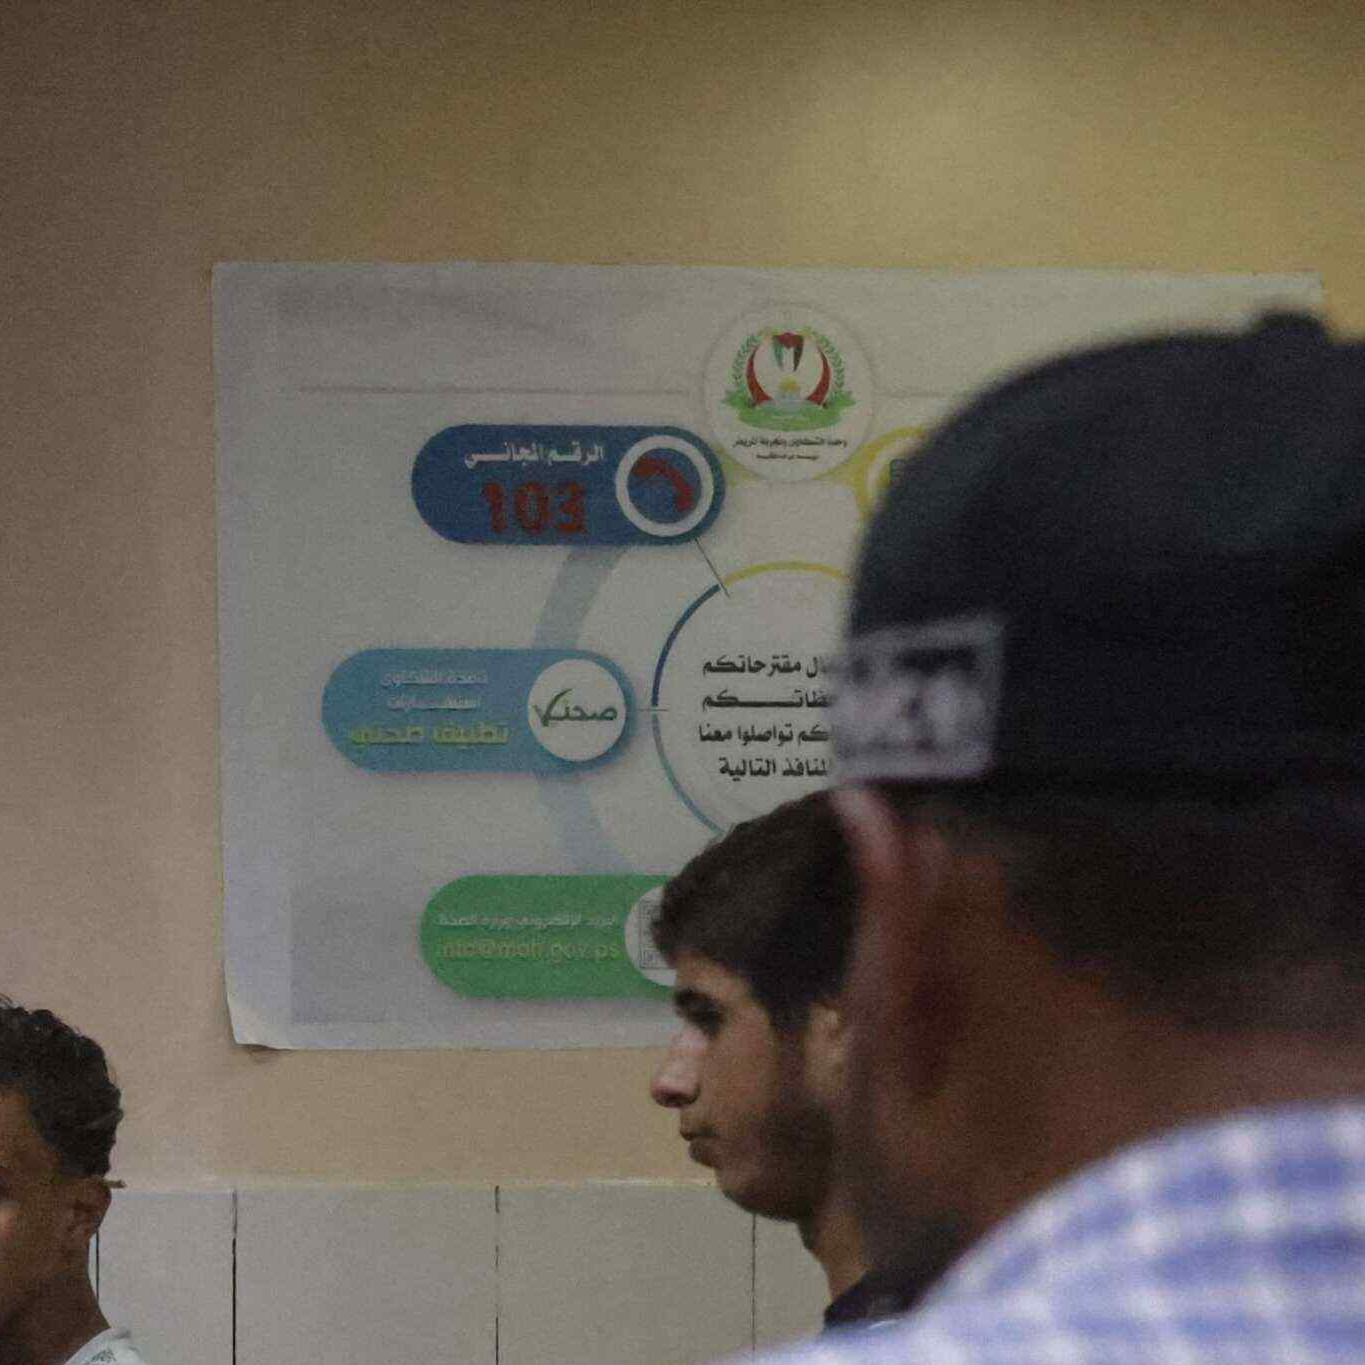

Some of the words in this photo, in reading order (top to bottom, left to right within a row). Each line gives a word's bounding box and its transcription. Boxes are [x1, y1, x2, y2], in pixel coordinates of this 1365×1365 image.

[481, 481, 588, 535] 103
[702, 654, 802, 678] مقترحاتكم
[737, 723, 794, 747] تواصلوا
[718, 757, 777, 782] التالية
